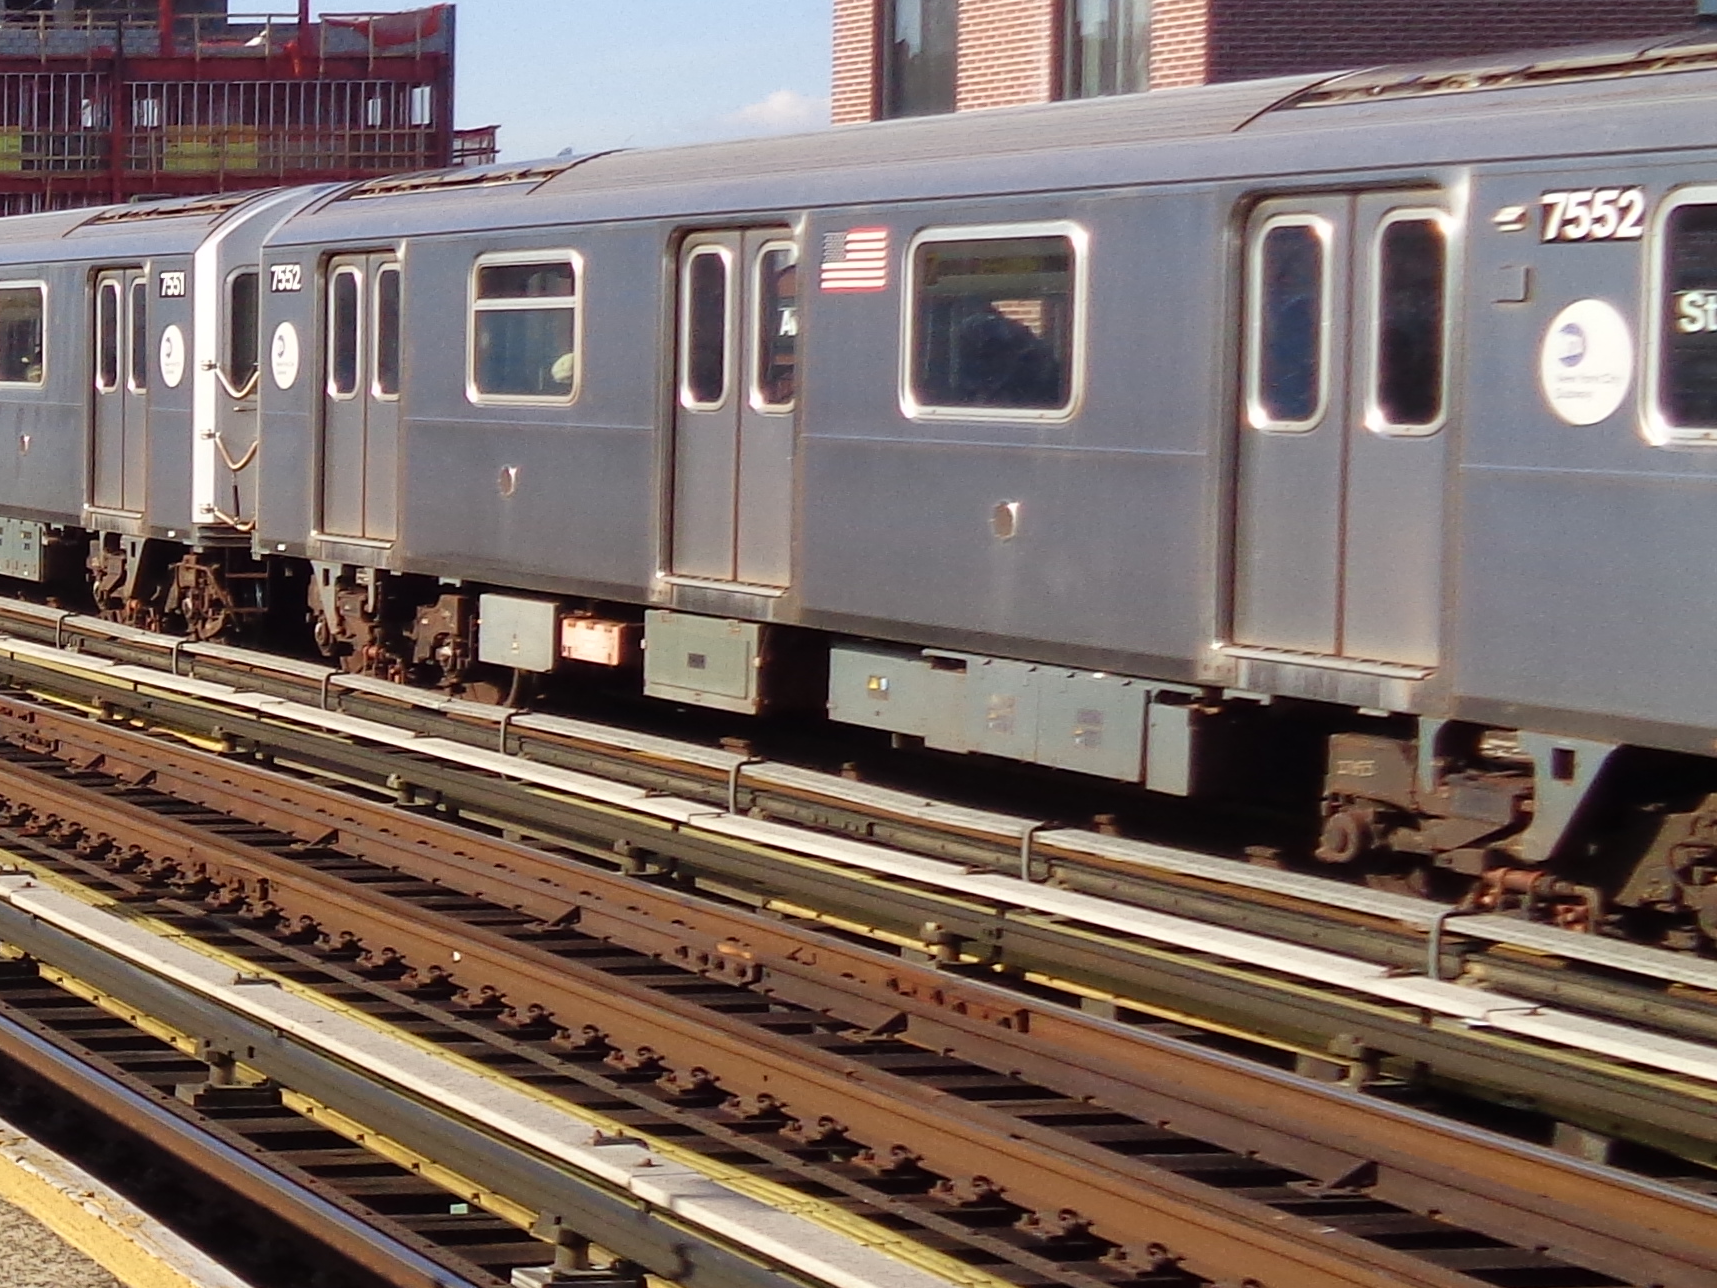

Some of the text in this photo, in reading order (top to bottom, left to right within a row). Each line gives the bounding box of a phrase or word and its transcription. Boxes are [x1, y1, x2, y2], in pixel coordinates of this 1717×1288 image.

[1540, 189, 1645, 241] 7552
[160, 271, 185, 296] 7551
[270, 264, 302, 291] 7552
